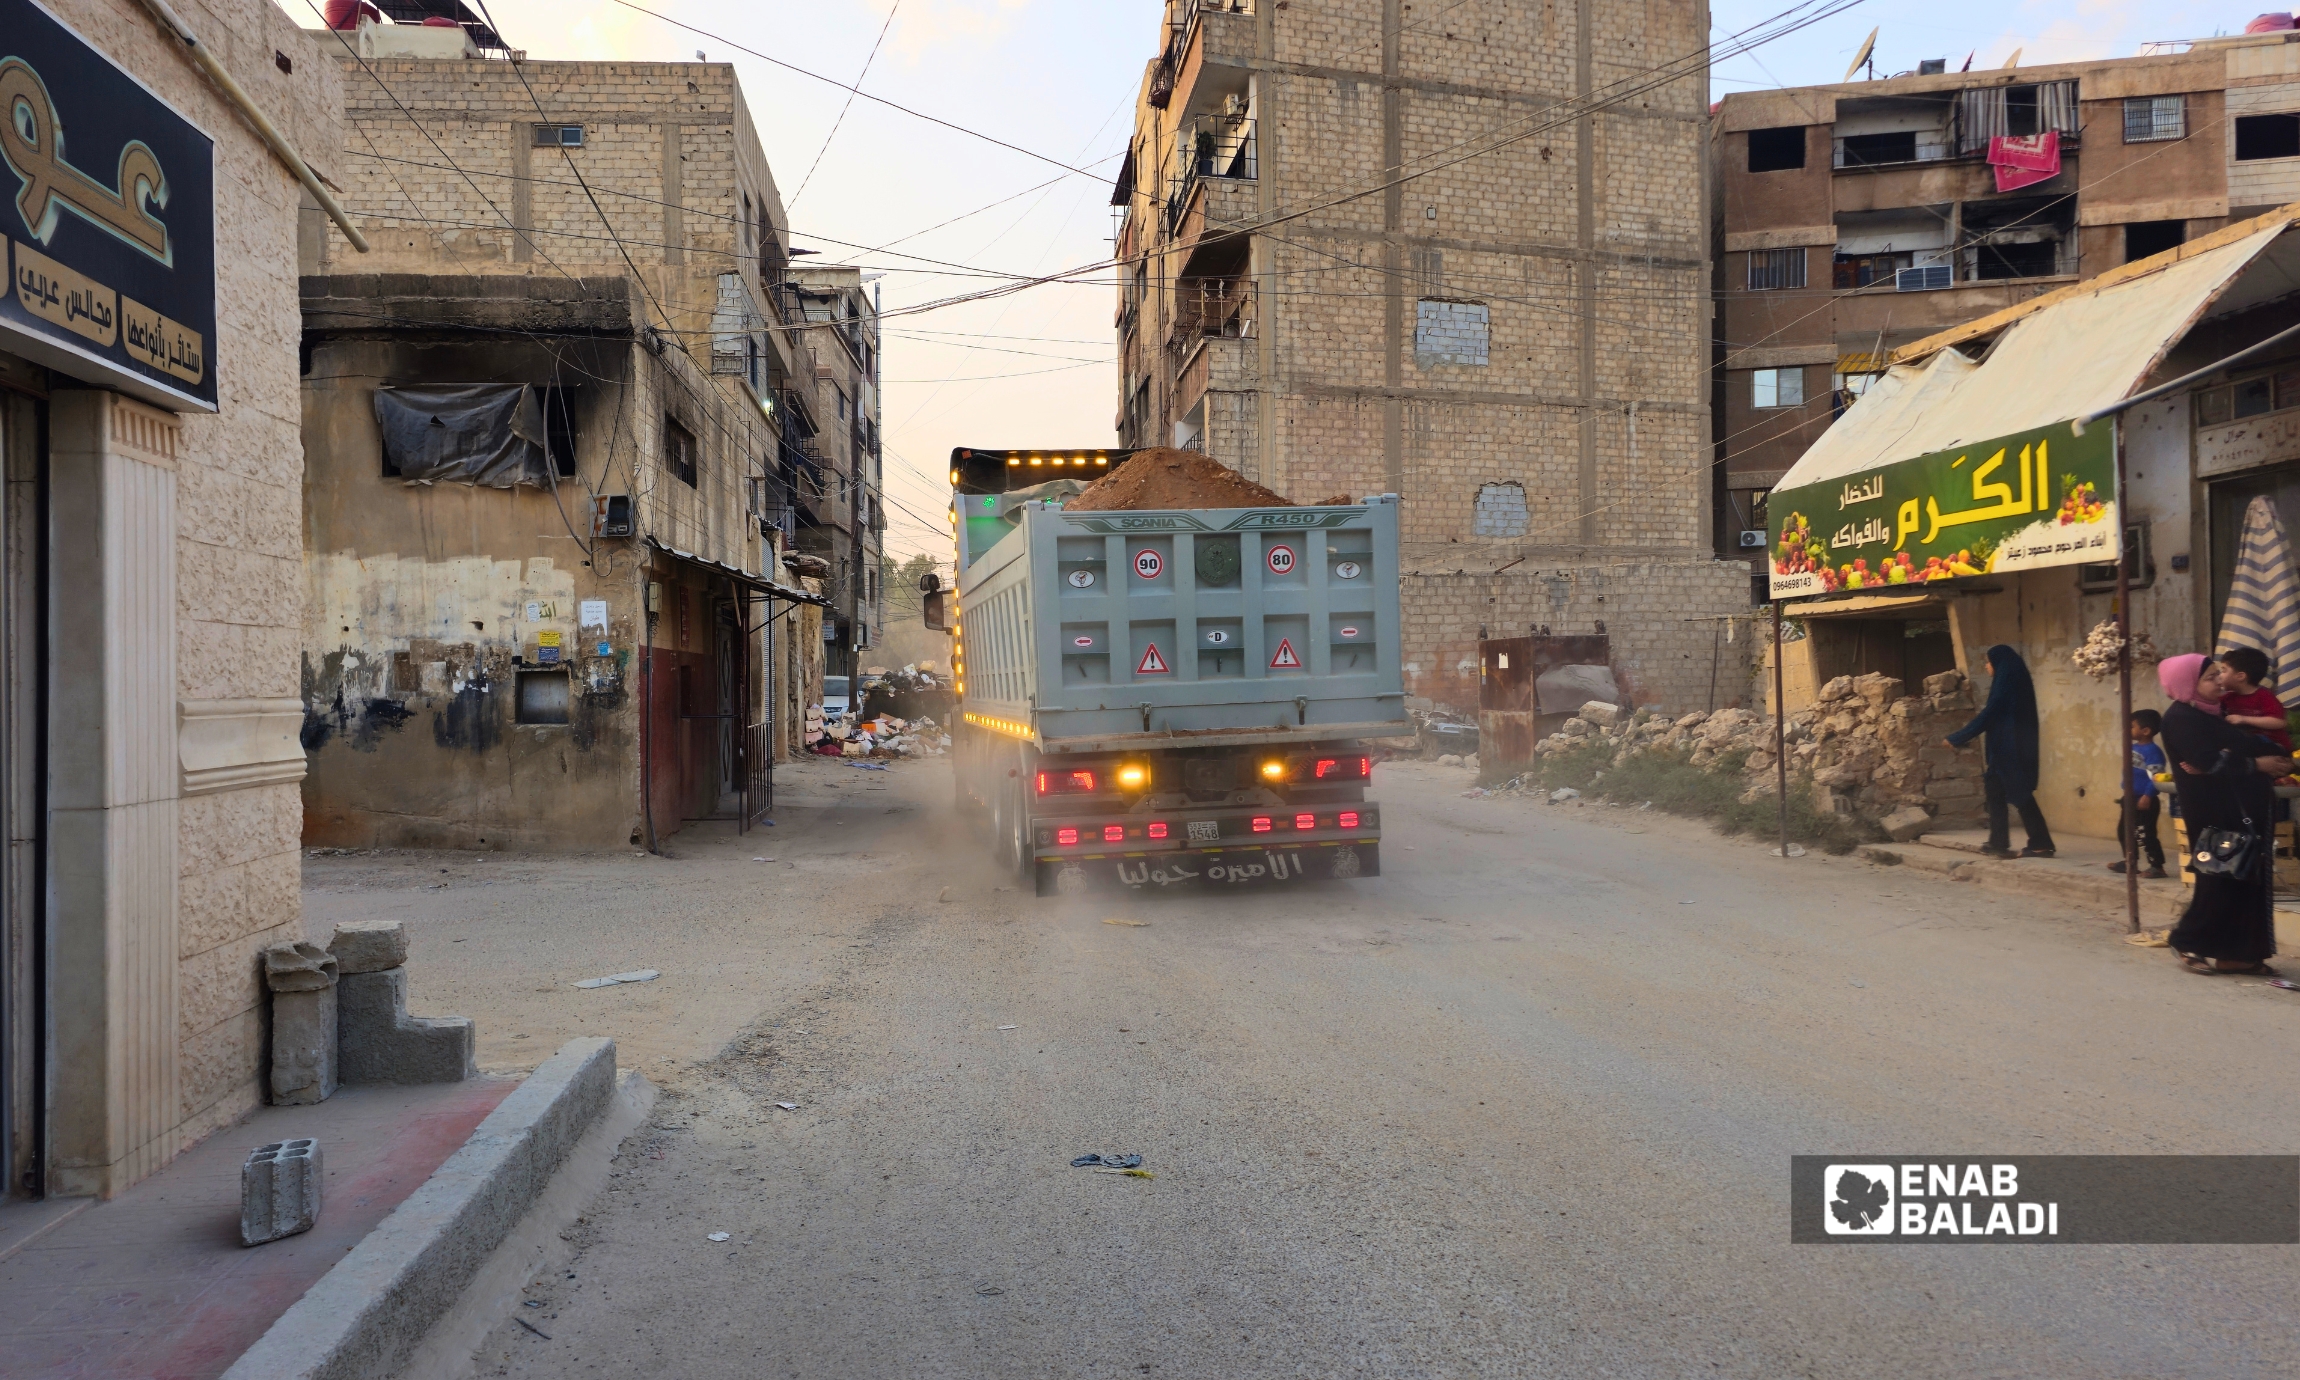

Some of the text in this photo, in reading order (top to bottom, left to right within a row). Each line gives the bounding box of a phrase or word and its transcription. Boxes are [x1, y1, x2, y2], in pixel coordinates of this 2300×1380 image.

[19, 265, 112, 334] مجالس عربي
[127, 314, 200, 374] ستائر بأنواعها
[1838, 474, 1883, 511] للخضار
[1121, 518, 1177, 528] SCANIA
[1261, 514, 1315, 525] R450
[1831, 517, 1890, 549] والفواكه
[1139, 558, 1158, 570] 90
[1272, 554, 1291, 566] 80
[1773, 577, 1812, 591] 0964698143
[1214, 632, 1222, 642] D
[1190, 829, 1218, 840] 1548
